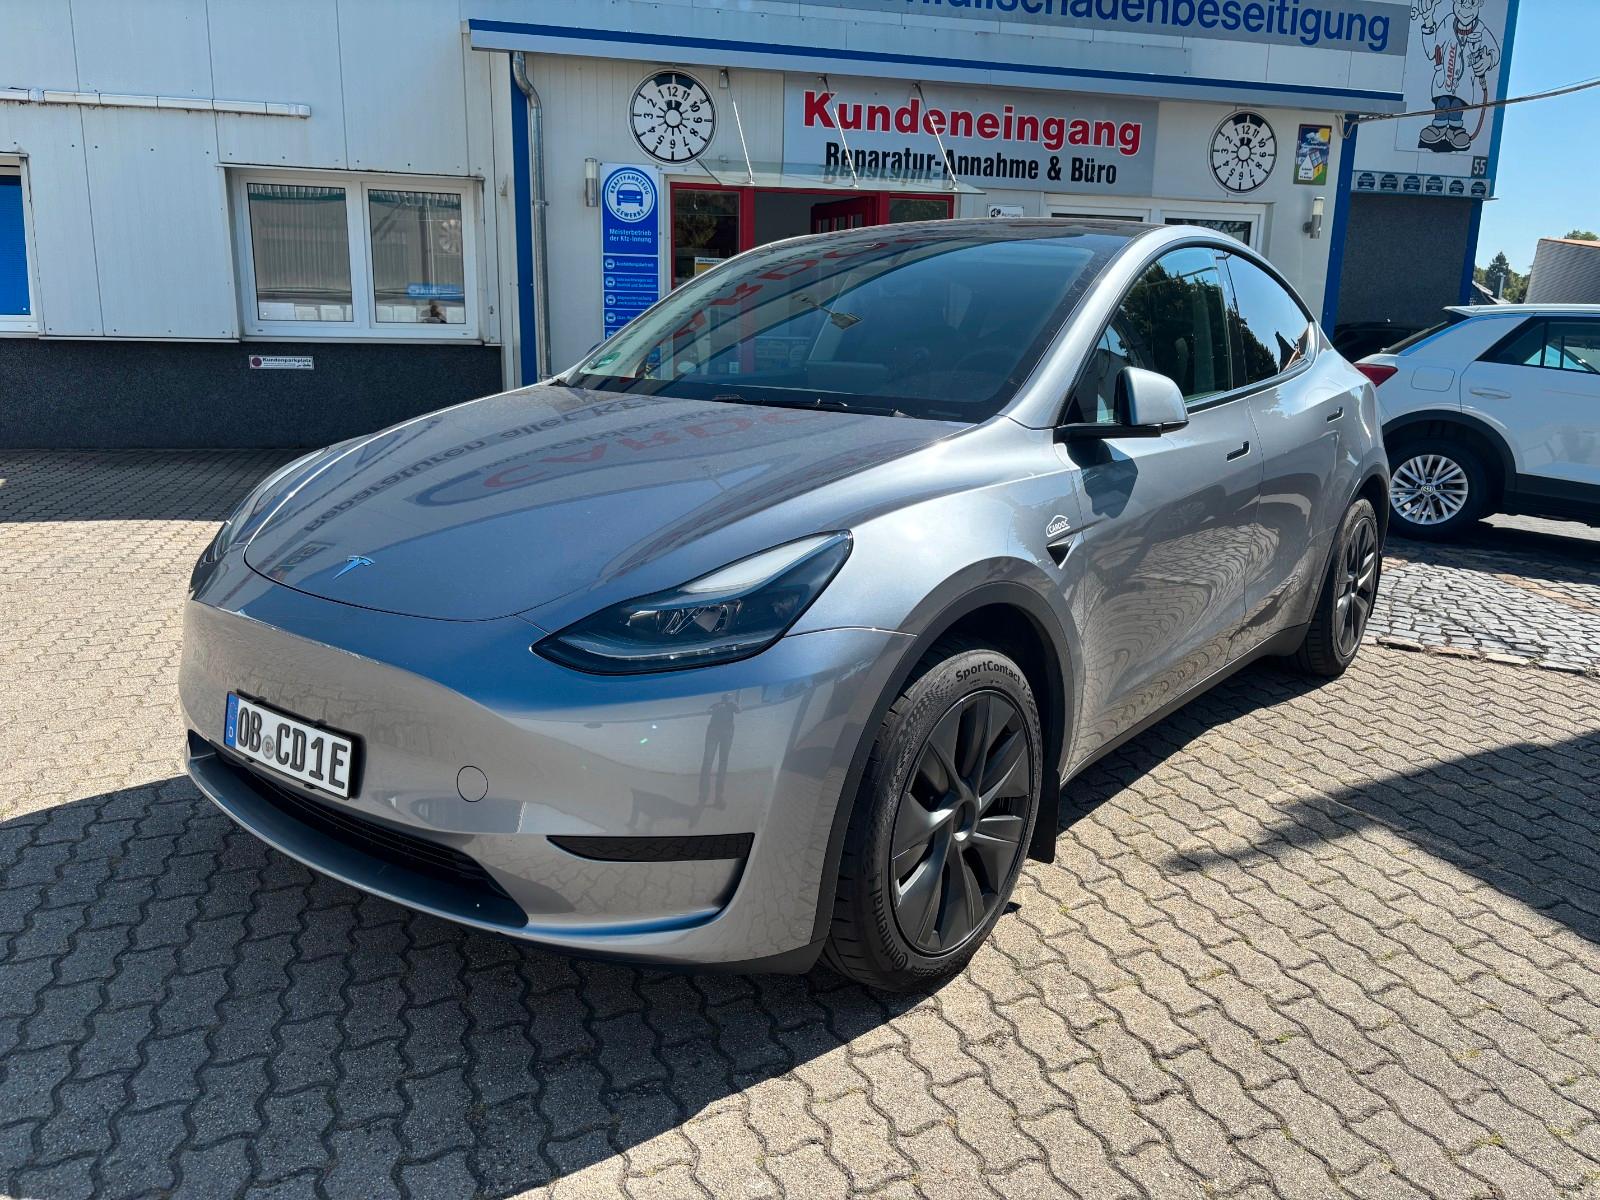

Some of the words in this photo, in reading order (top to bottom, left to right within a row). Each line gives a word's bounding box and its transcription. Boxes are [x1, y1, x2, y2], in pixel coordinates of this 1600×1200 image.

[658, 89, 664, 99] 1
[667, 86, 678, 97] 12
[681, 90, 691, 101] 11
[647, 98, 657, 108] 2
[643, 112, 653, 120] 3
[804, 89, 1143, 156] Kundeneingang
[689, 127, 699, 137] 8
[656, 134, 665, 145] 5
[669, 139, 676, 149] 6
[682, 136, 689, 147] 7
[825, 142, 1039, 180] Reparatur-Annahme
[1047, 158, 1062, 182] &
[1071, 156, 1117, 185] Büro
[1473, 159, 1486, 175] 55
[609, 228, 652, 236] Meisterbetrieb
[955, 660, 1021, 685] SportContact
[237, 706, 262, 753] OB
[275, 722, 348, 790] CD1E
